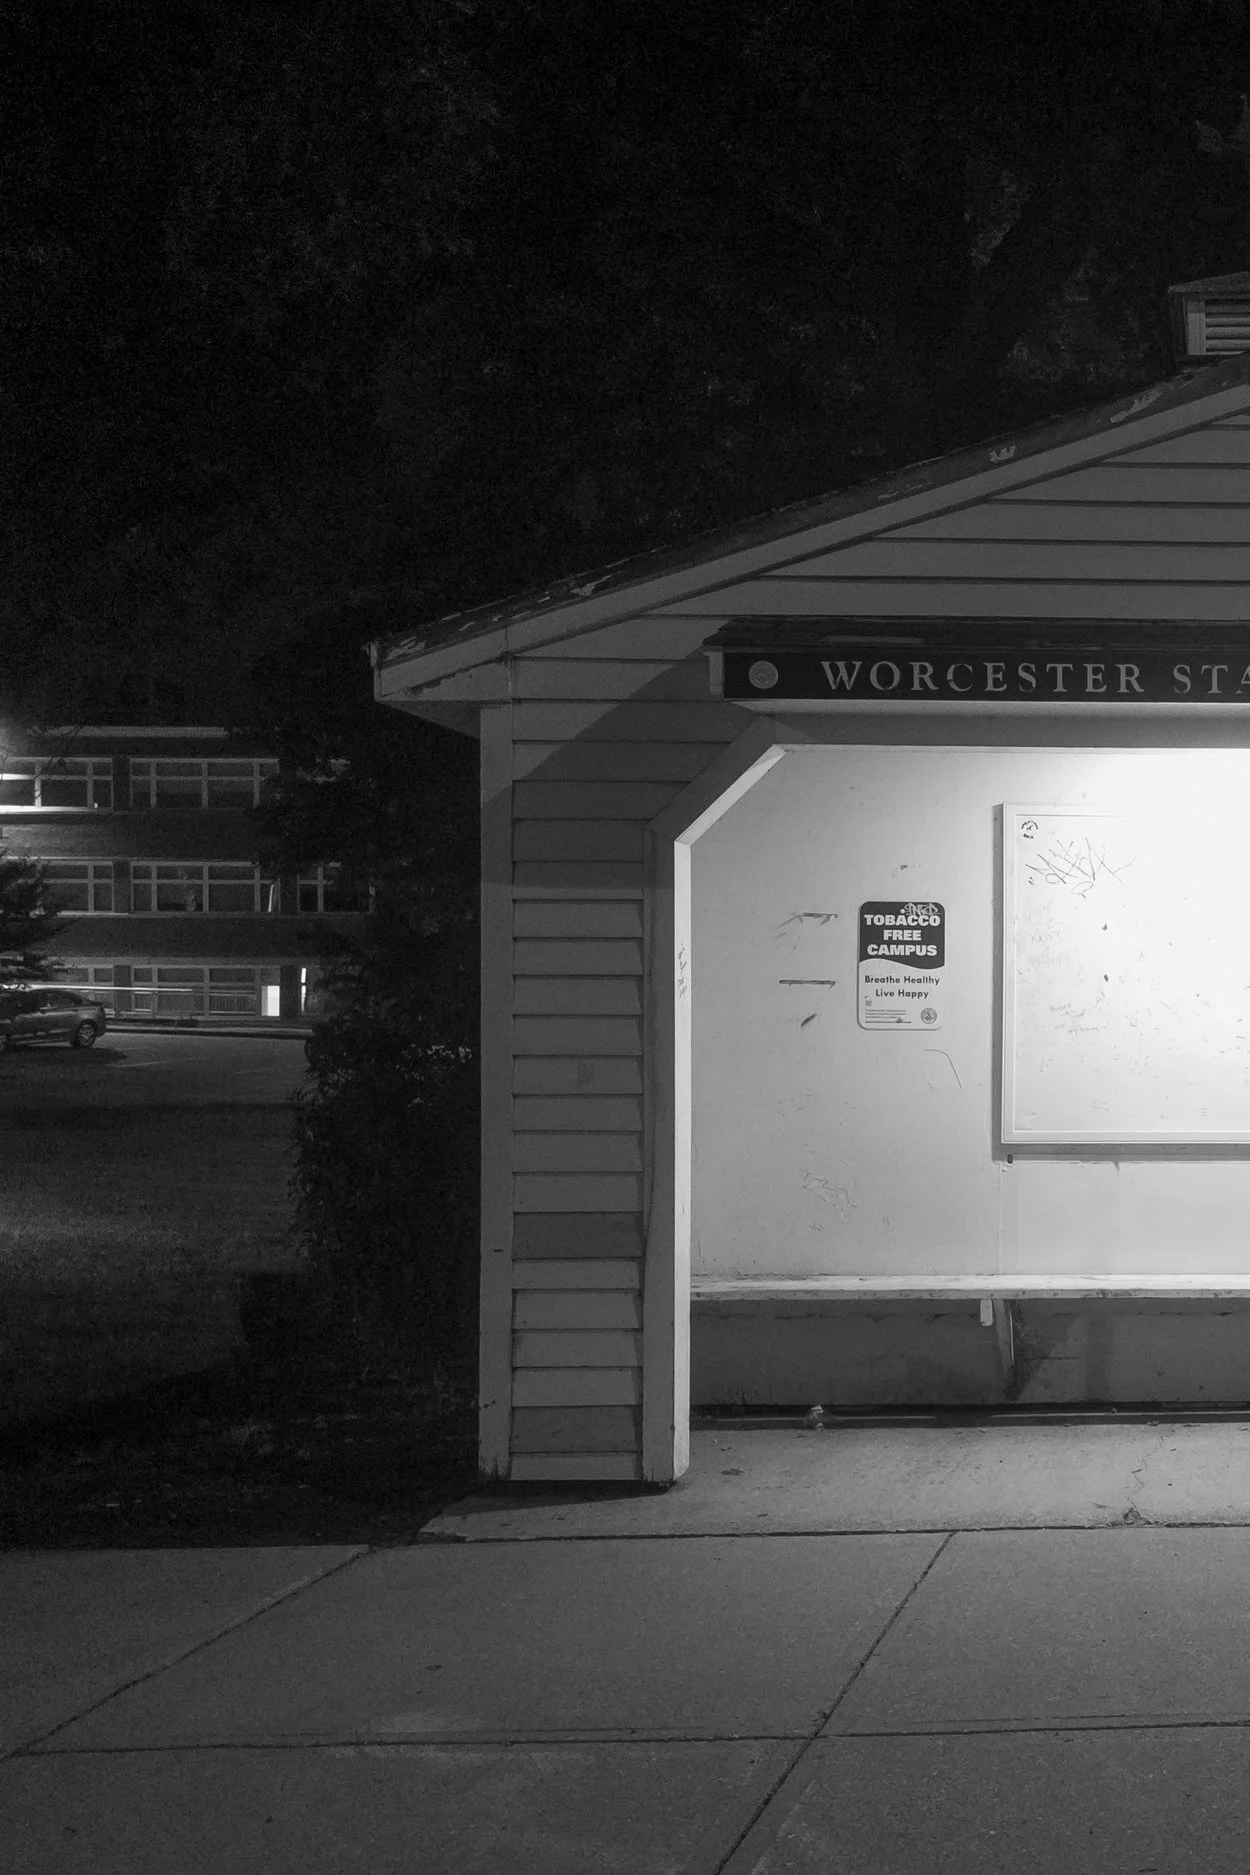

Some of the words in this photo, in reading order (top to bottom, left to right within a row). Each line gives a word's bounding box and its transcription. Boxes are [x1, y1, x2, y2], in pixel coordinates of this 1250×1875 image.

[820, 660, 1145, 693] WORCESTER
[864, 914, 941, 926] TOBACCO
[883, 929, 922, 941] FREE
[867, 944, 938, 956] CAMPUS
[864, 975, 901, 984] Breathe
[903, 975, 940, 986] Healthy
[875, 989, 895, 998] Live
[897, 989, 929, 1000] Happy
